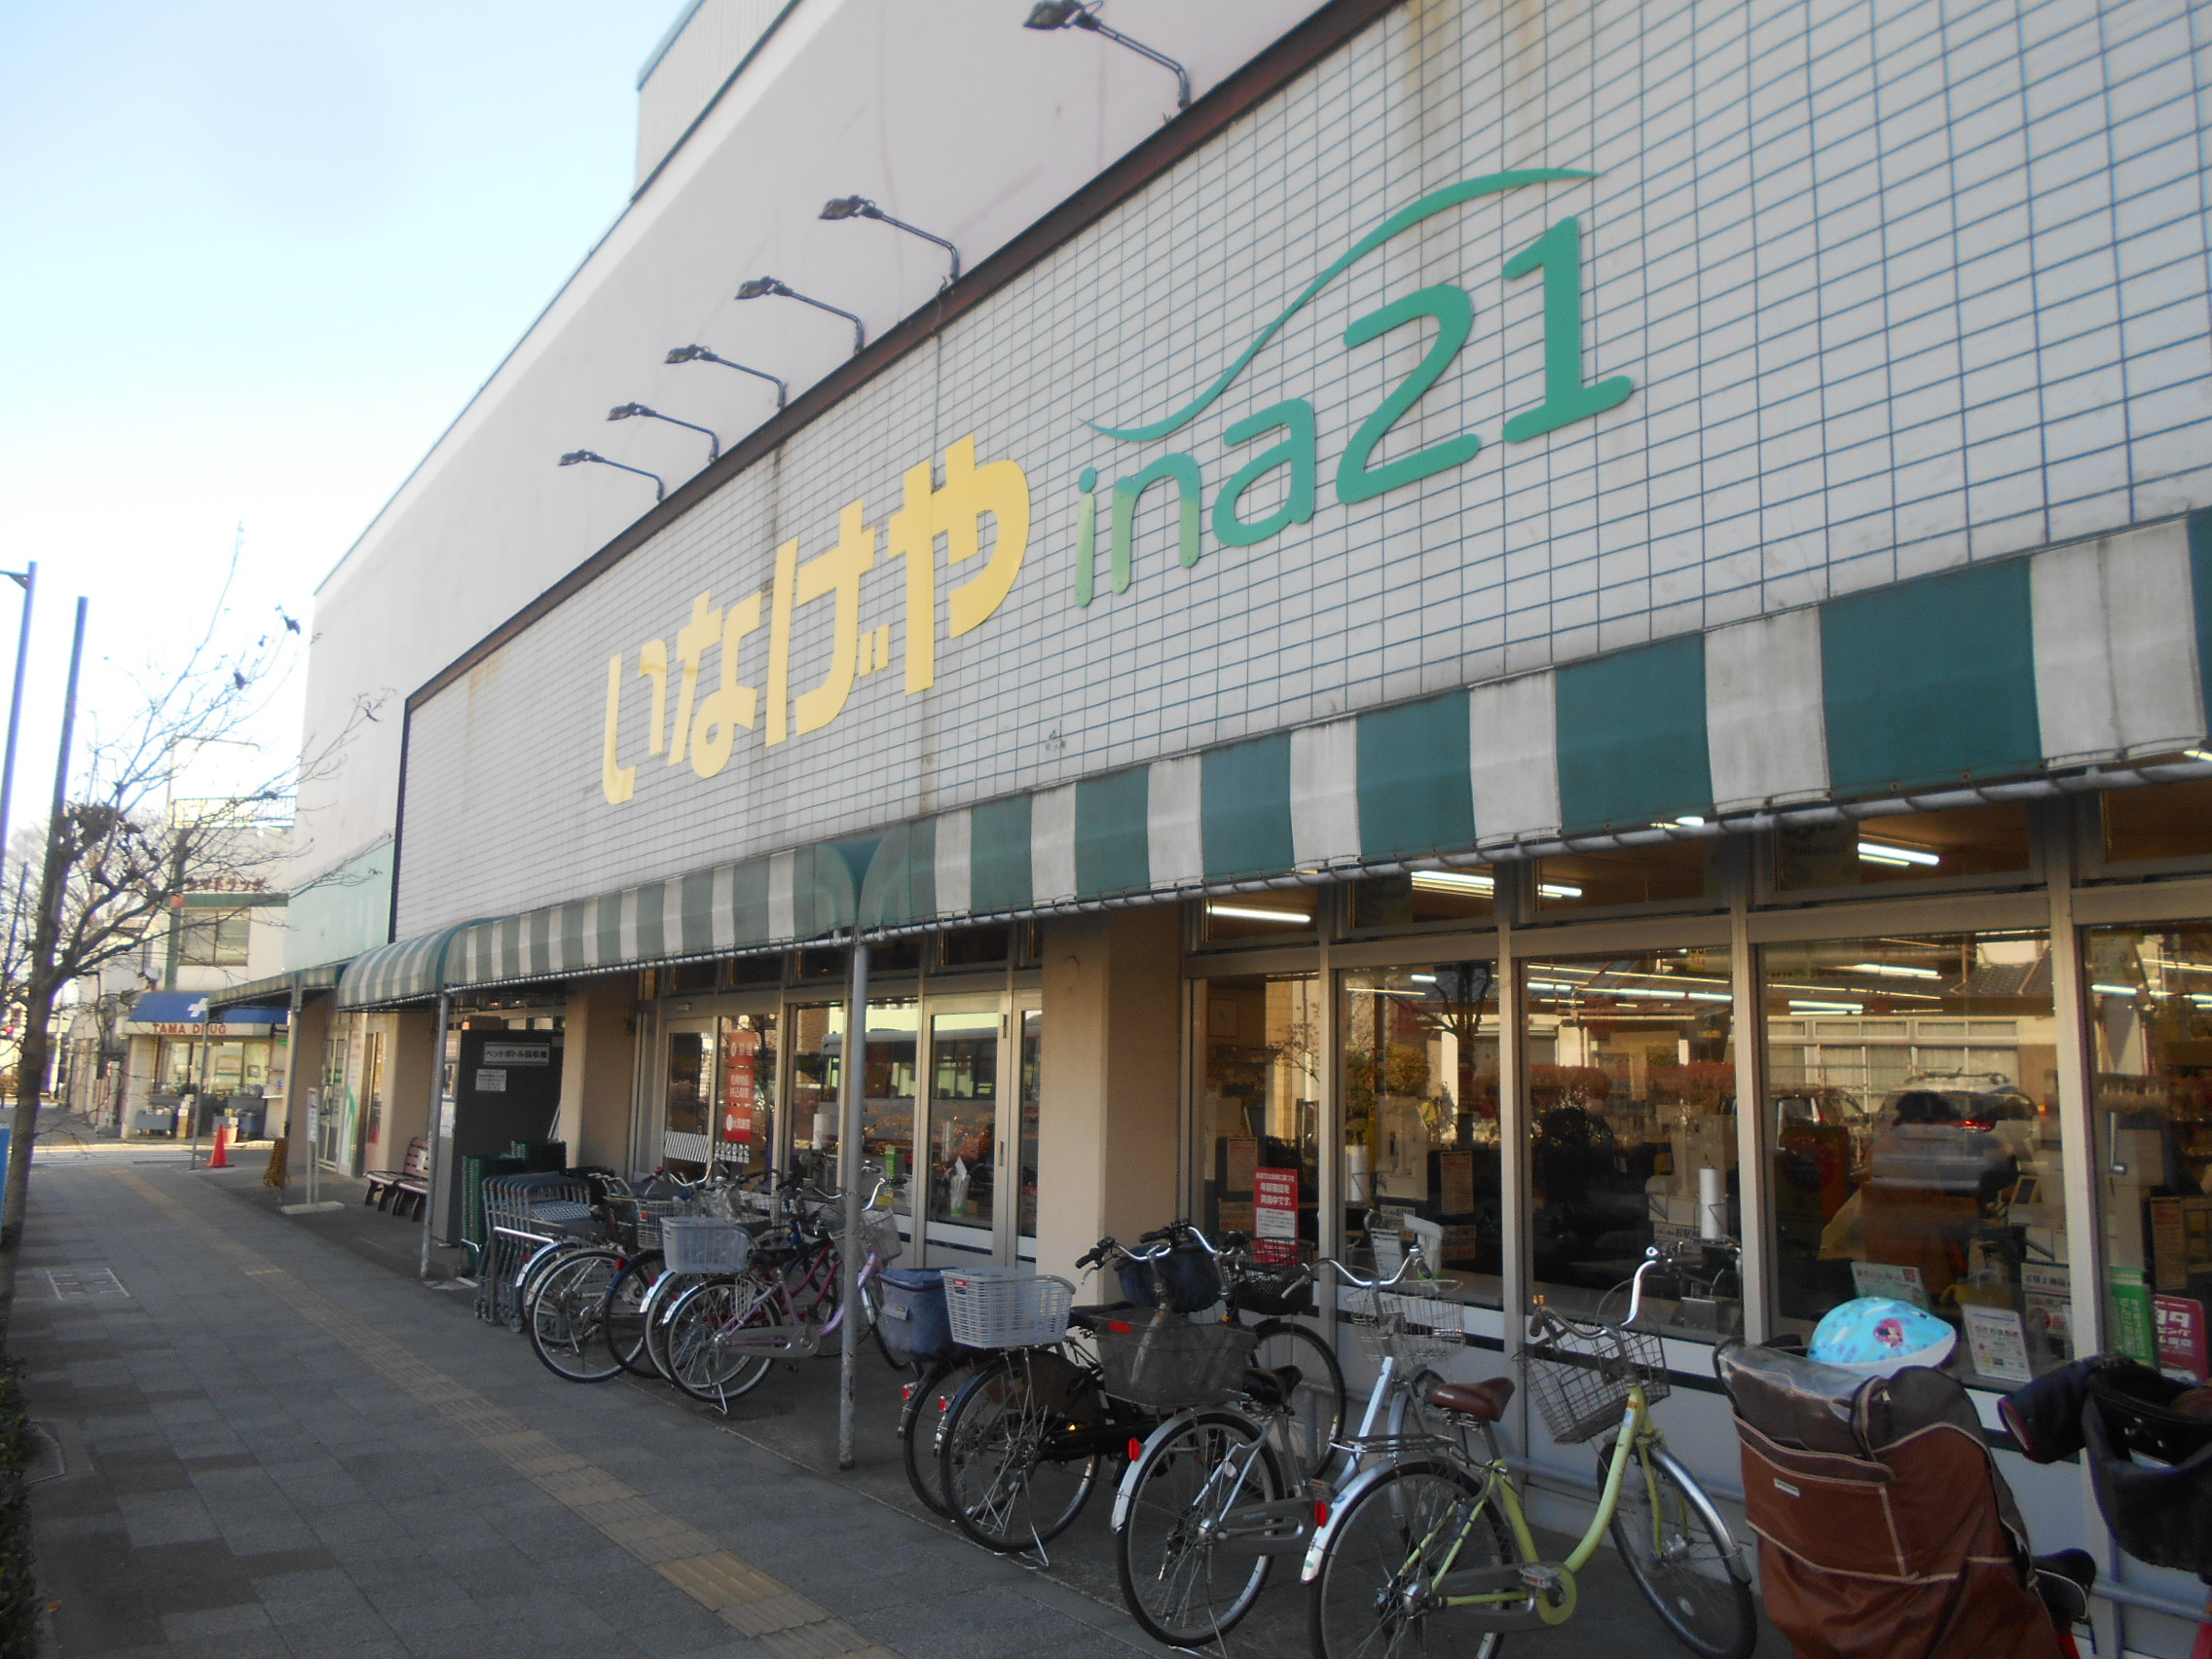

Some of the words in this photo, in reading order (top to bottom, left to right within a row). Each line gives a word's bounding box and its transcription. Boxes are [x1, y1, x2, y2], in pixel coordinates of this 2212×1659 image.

[1074, 215, 1635, 608] ina21
[602, 433, 1030, 805] いなげや
[153, 1023, 186, 1034] TAMA
